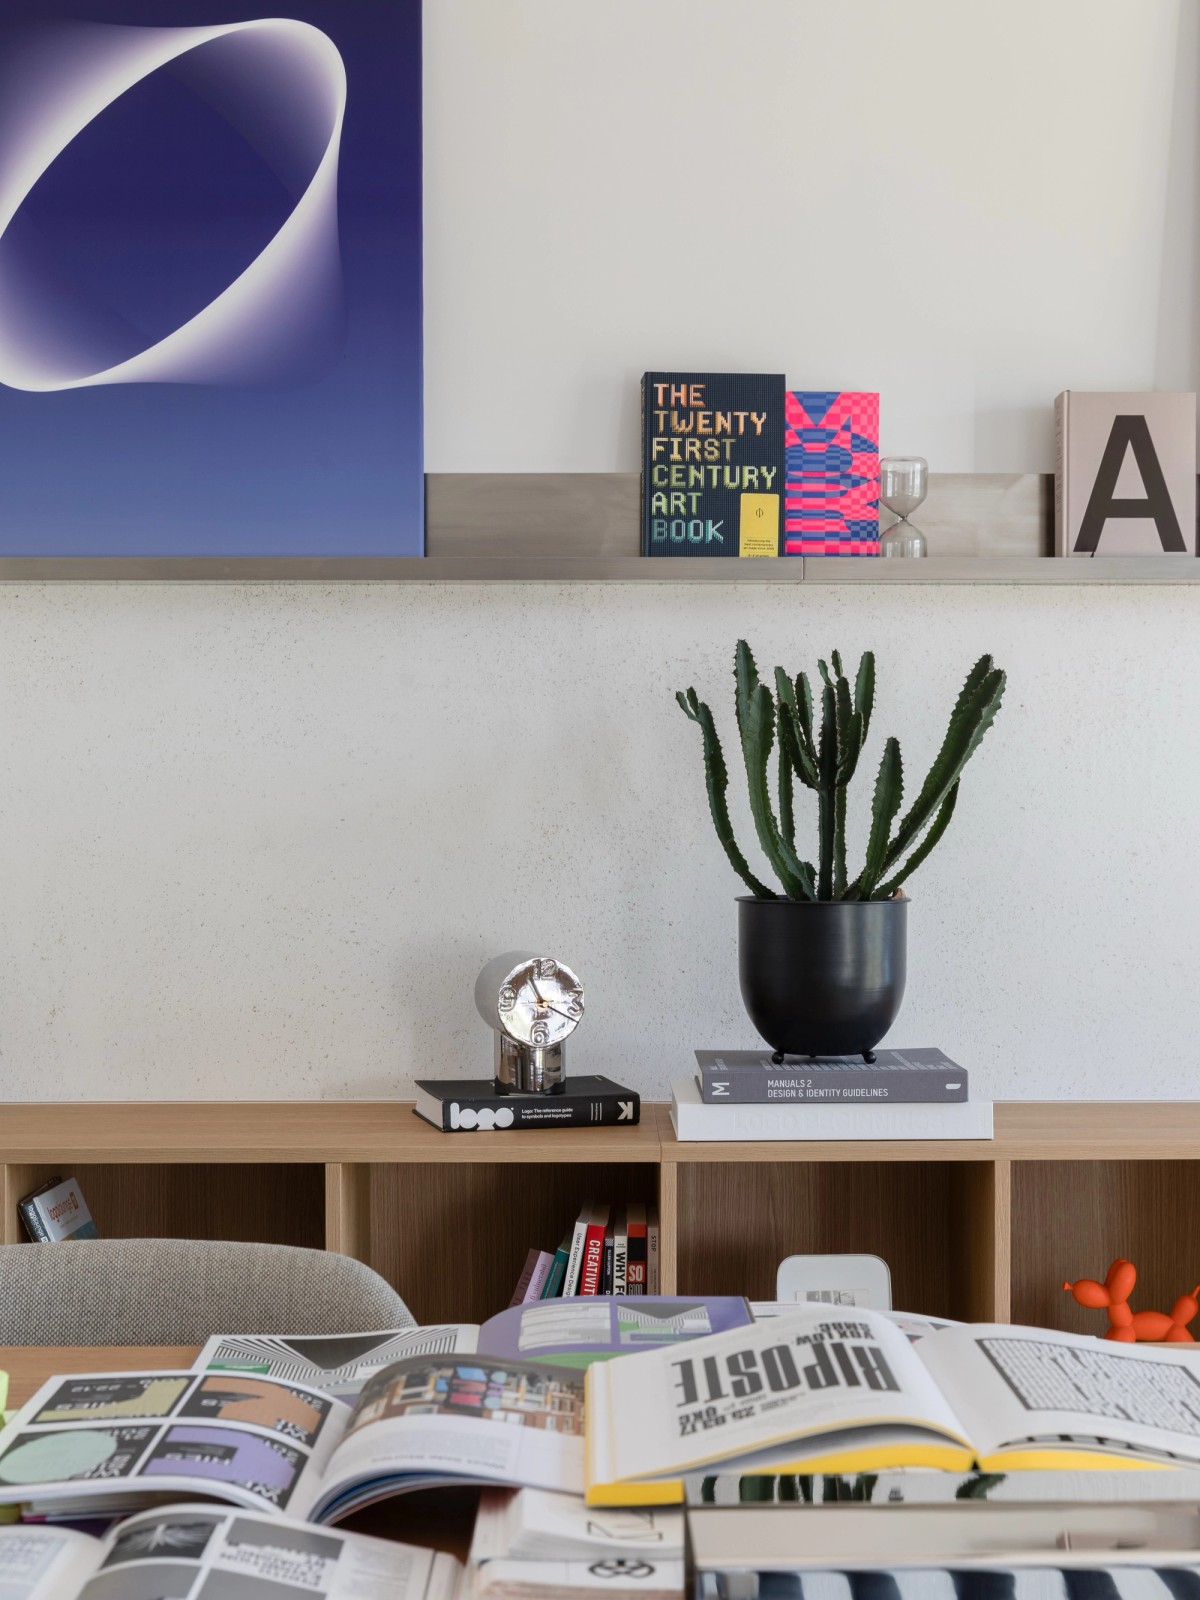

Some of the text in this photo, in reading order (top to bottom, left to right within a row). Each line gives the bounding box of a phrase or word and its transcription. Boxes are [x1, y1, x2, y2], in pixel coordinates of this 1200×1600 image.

[654, 383, 706, 407] THE
[653, 410, 767, 435] TWENTY
[652, 438, 736, 462] FIRST
[652, 465, 776, 489] CENTURY
[1073, 415, 1187, 552] A
[652, 492, 703, 516] ART
[652, 519, 724, 544] BOOK
[767, 1080, 812, 1088] MANUALS 2
[767, 1088, 889, 1098] DESIGN & IDENTITY GUIDELINES
[569, 1247, 580, 1278] Experience
[584, 1239, 600, 1296] CREATIVIT
[615, 1252, 625, 1281] WHY
[629, 1265, 643, 1282] SO
[565, 1279, 574, 1298] Desig
[672, 1342, 902, 1407] RIPOSTE
